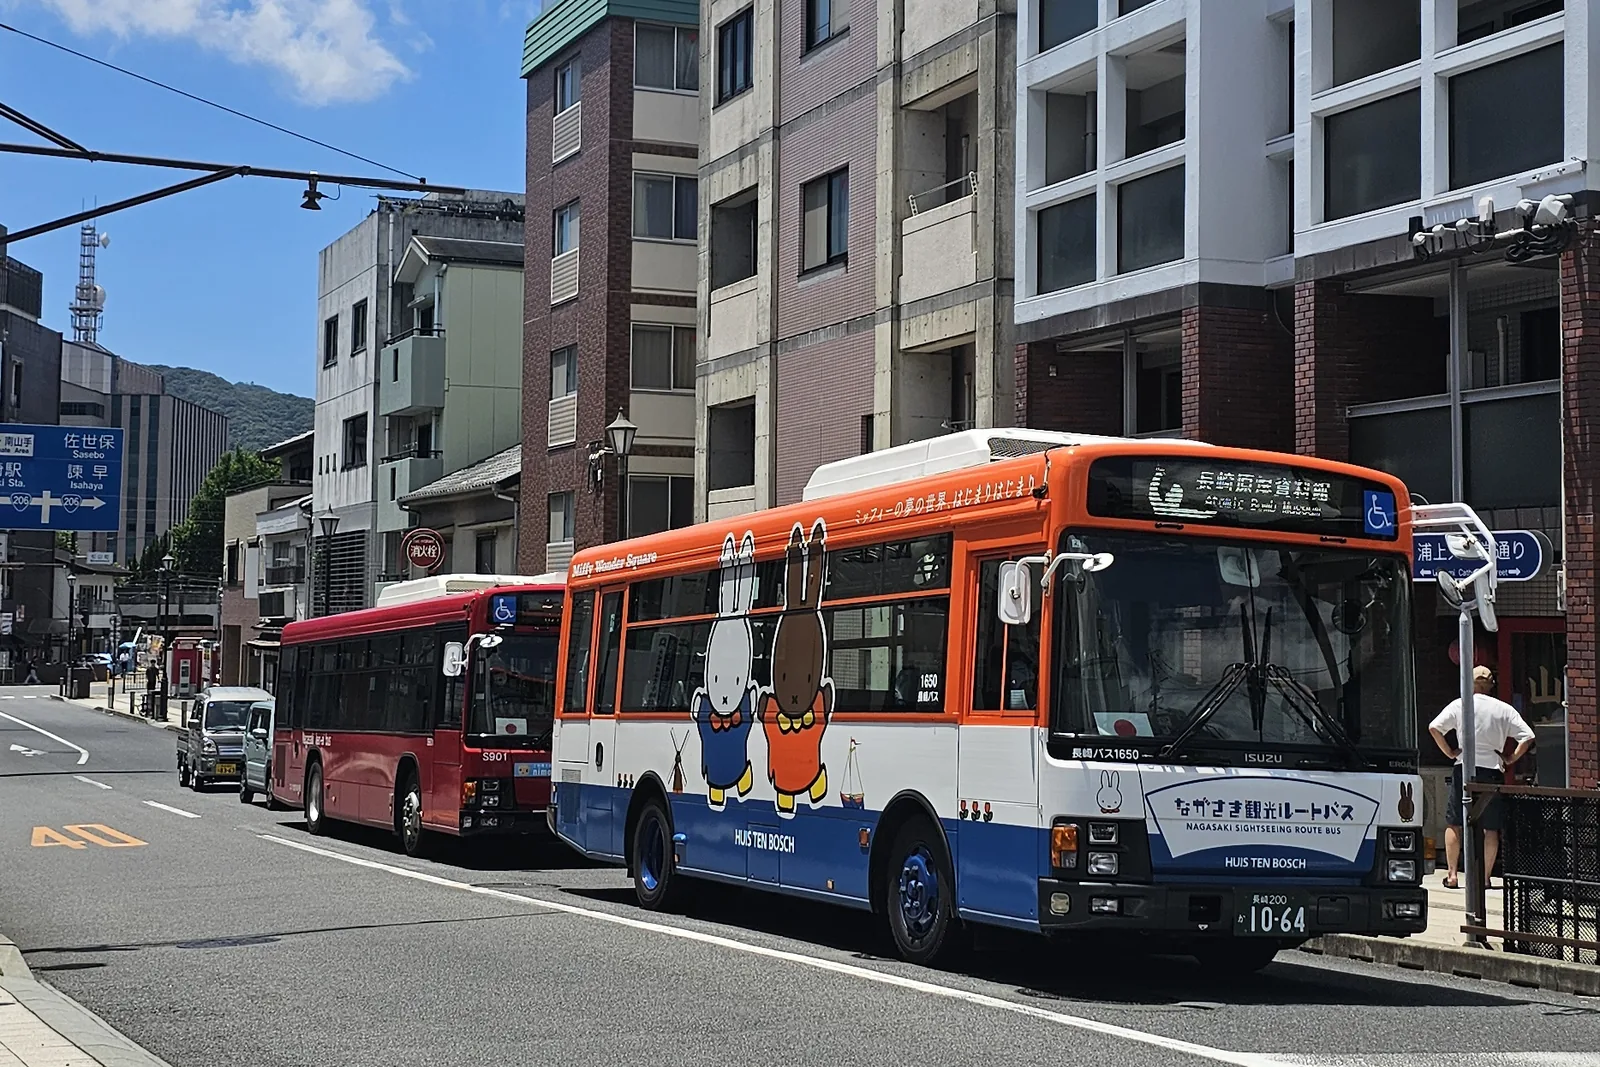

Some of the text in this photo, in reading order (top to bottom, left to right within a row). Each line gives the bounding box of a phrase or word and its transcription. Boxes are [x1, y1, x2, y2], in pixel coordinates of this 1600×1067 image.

[64, 433, 115, 449] 佐世保
[73, 449, 105, 459] Sasebo
[8, 479, 26, 488] Sta.
[70, 481, 104, 491] Isahaya
[13, 496, 29, 505] 206
[64, 497, 80, 506] 206
[410, 544, 438, 558] 消火栓
[1418, 541, 1525, 561] 浦上通り
[572, 552, 657, 578] Miffy Wonder Square
[920, 673, 938, 688] 1650
[482, 752, 507, 761] S901
[1244, 753, 1282, 763] ISUZU
[1174, 796, 1355, 821] ながさき観光ルートバス
[1186, 822, 1342, 835] NAGASAKI SIGHTSEEING ROUTE BUS
[31, 823, 148, 850] 40
[734, 828, 795, 854] HUIS TEN BOSCH
[1225, 856, 1306, 869] HUIS TEN BOSCH
[1237, 905, 1306, 932] か 10-64
